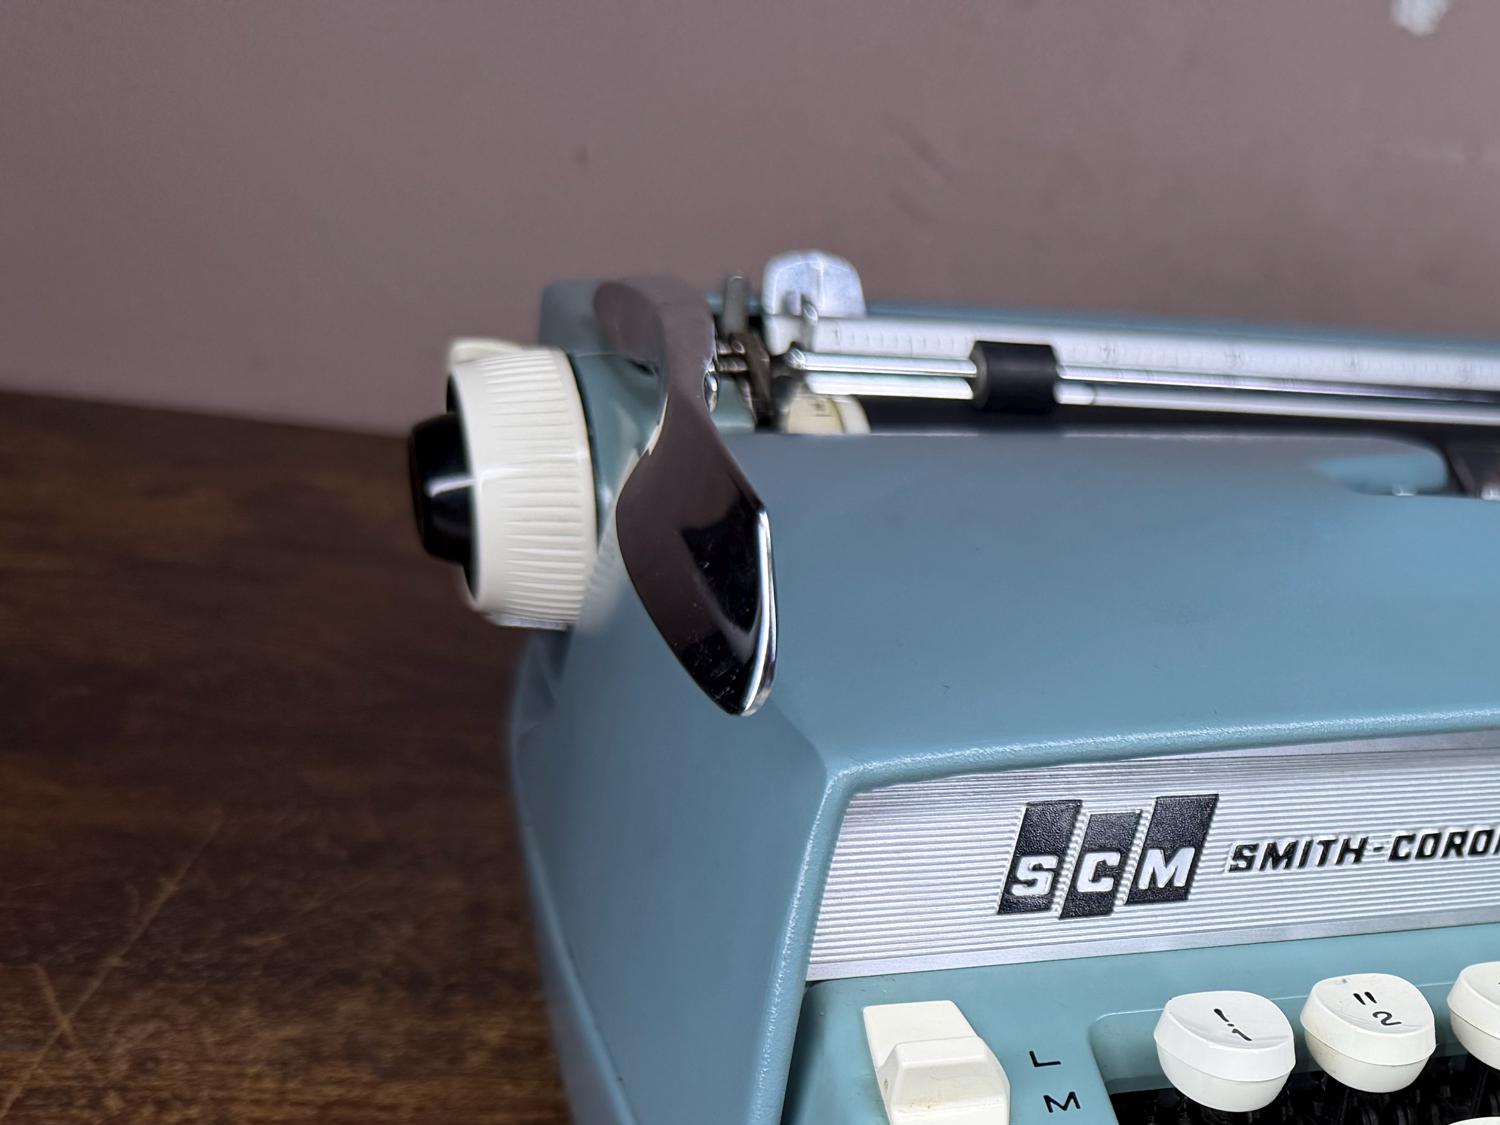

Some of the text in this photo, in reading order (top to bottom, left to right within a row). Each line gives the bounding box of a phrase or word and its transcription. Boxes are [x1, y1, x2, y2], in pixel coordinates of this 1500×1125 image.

[1011, 847, 1196, 896] SCM
[1373, 1011, 1401, 1026] 2
[1029, 1051, 1061, 1067] L
[1043, 1092, 1080, 1113] M
